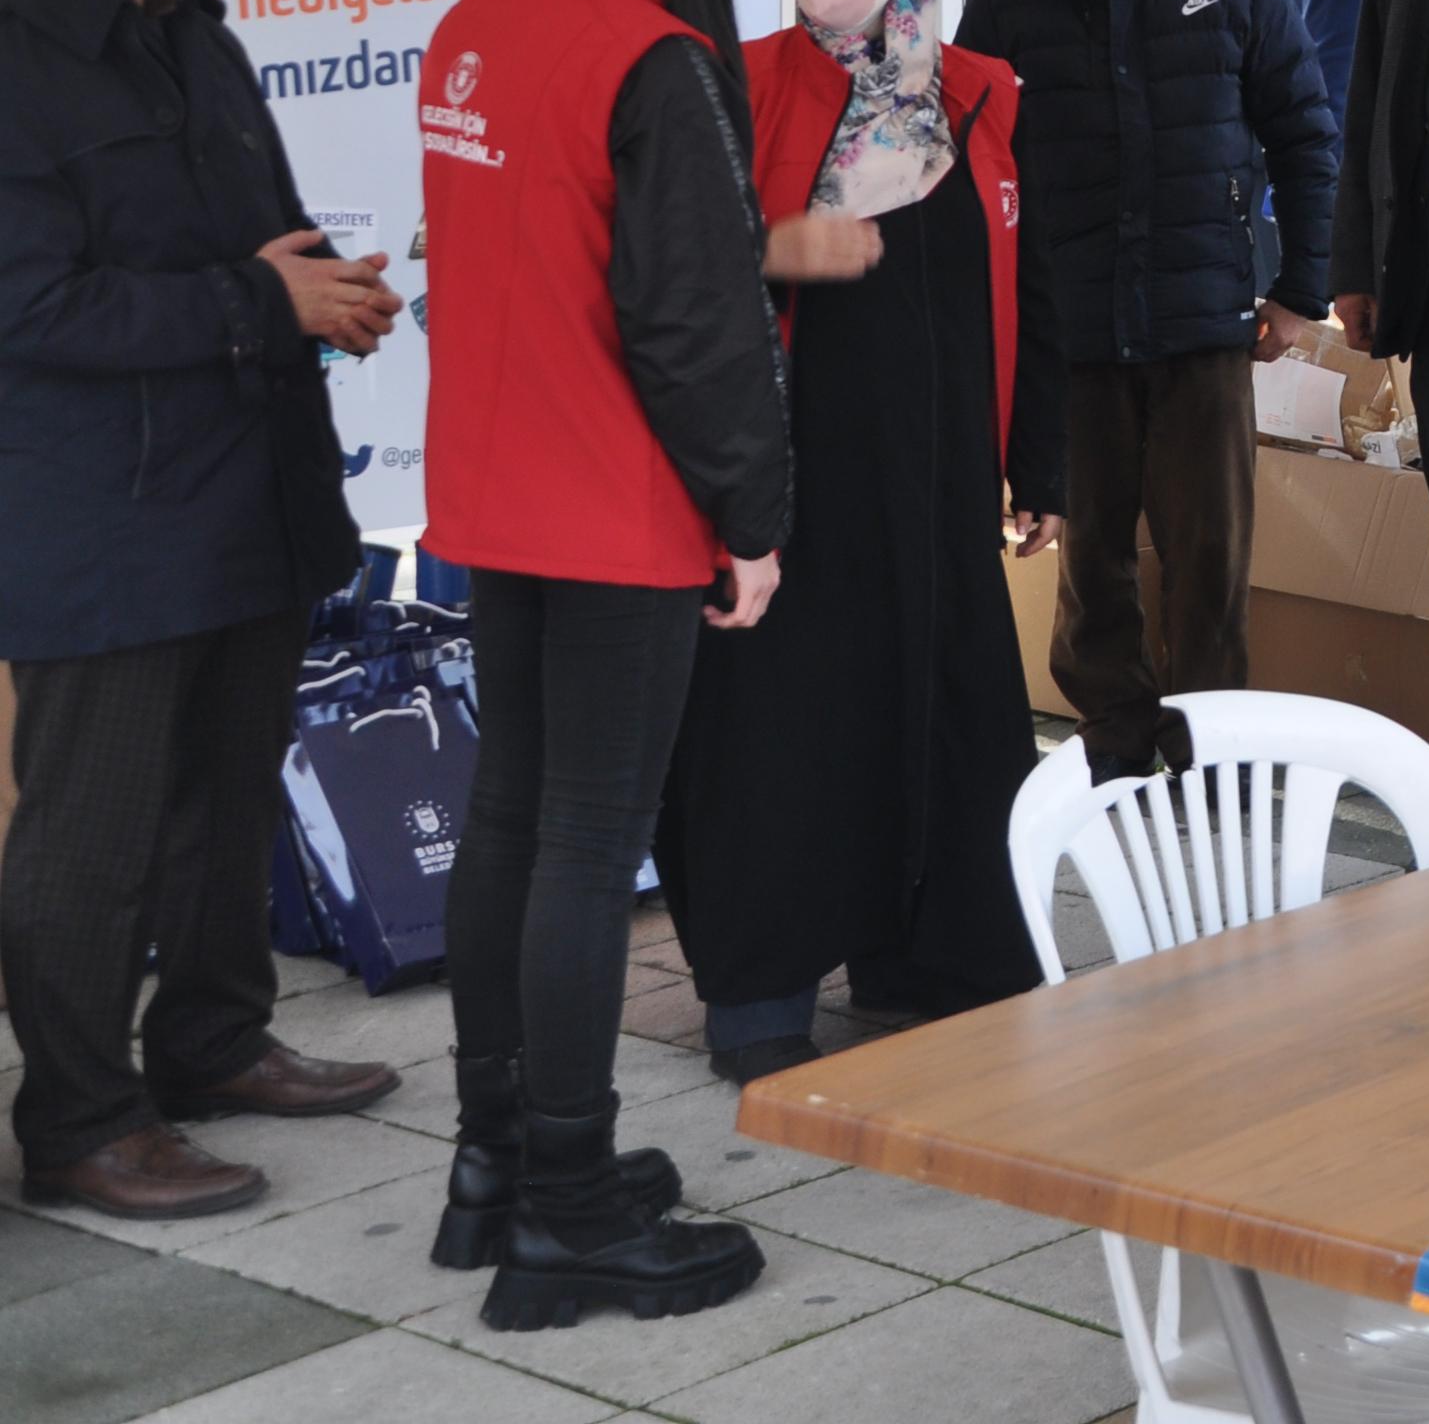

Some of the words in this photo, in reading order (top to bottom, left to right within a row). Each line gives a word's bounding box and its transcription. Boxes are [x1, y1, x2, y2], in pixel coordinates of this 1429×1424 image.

[258, 39, 426, 100] mızdan
[312, 211, 375, 228] VERSİTEYE
[381, 445, 422, 470] @ge
[414, 840, 461, 858] BURS
